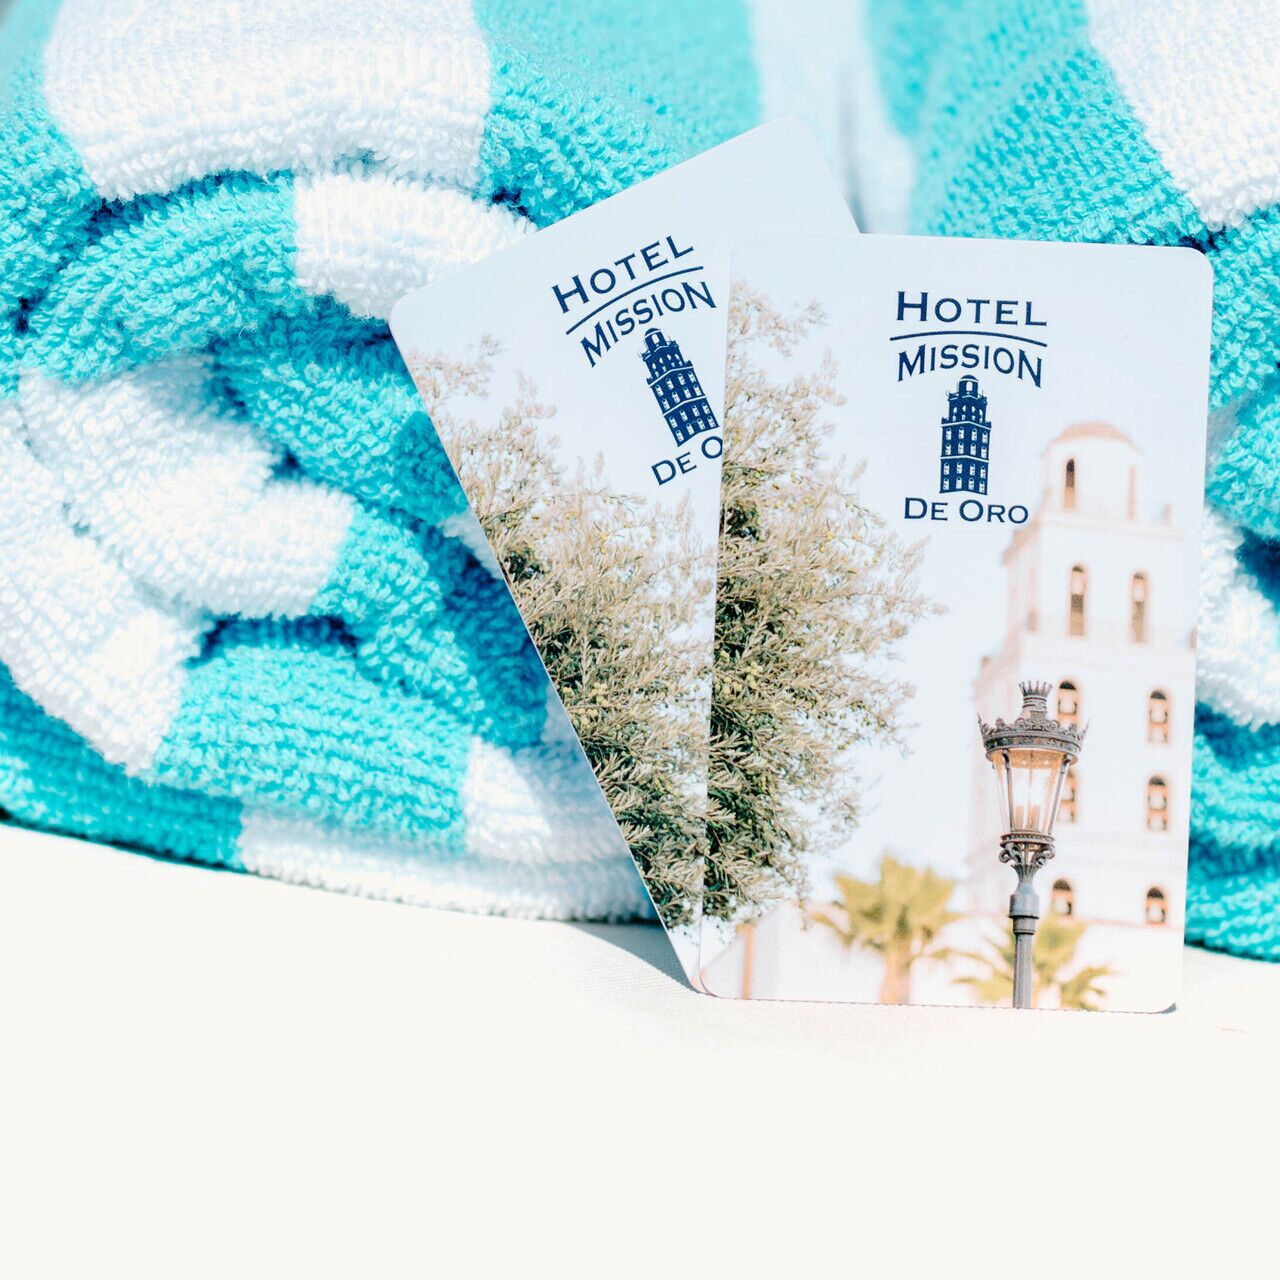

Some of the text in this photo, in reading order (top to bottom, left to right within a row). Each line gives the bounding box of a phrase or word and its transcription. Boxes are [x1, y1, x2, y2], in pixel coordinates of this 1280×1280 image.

[551, 234, 694, 314] HOTEL
[579, 281, 717, 368] MISSION
[896, 290, 1047, 327] HOTEL
[897, 344, 1043, 388] MISSION
[651, 451, 697, 486] DE
[903, 497, 1029, 524] DE ORO
